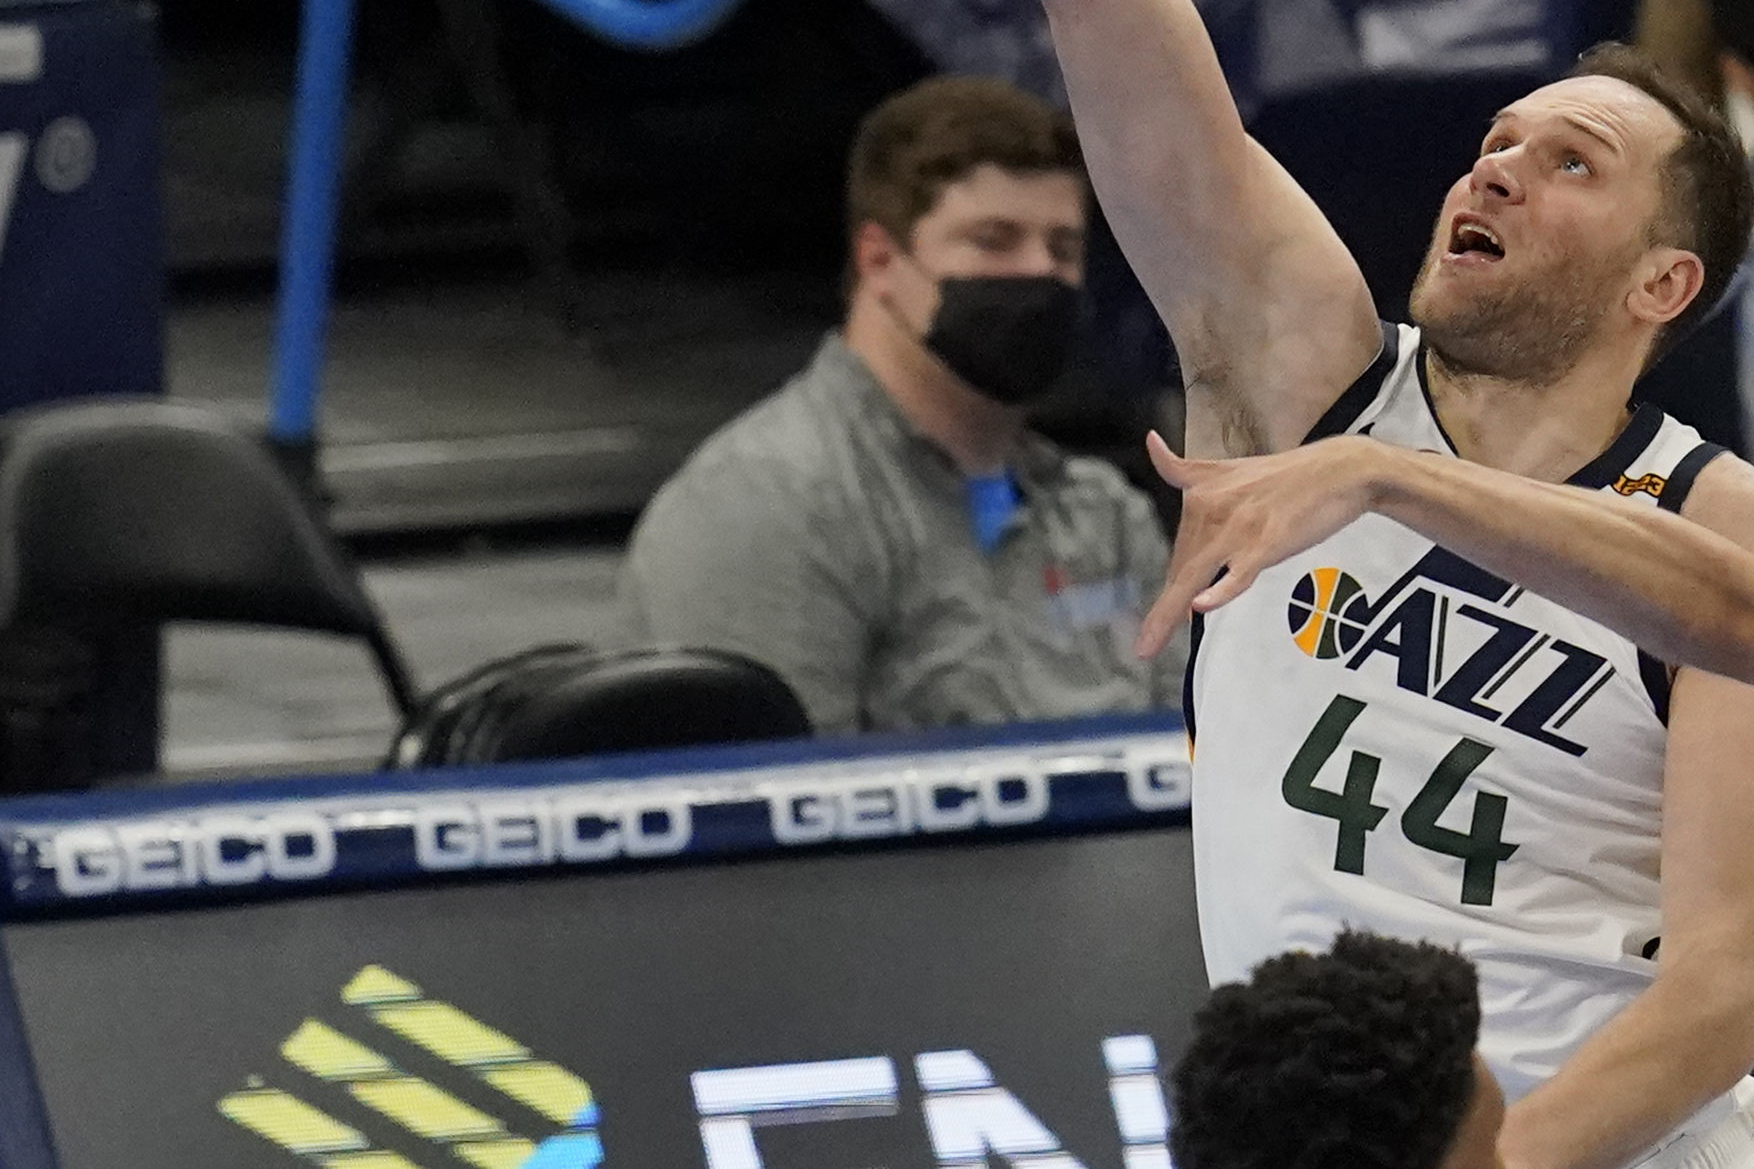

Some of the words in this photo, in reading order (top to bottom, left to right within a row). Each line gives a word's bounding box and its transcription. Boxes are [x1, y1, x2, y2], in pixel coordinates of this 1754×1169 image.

[1287, 543, 1617, 758] JAZZ
[55, 810, 337, 896] GEICO
[414, 792, 693, 871] GEICO
[769, 757, 1051, 845] GEICO
[1281, 693, 1521, 907] 44
